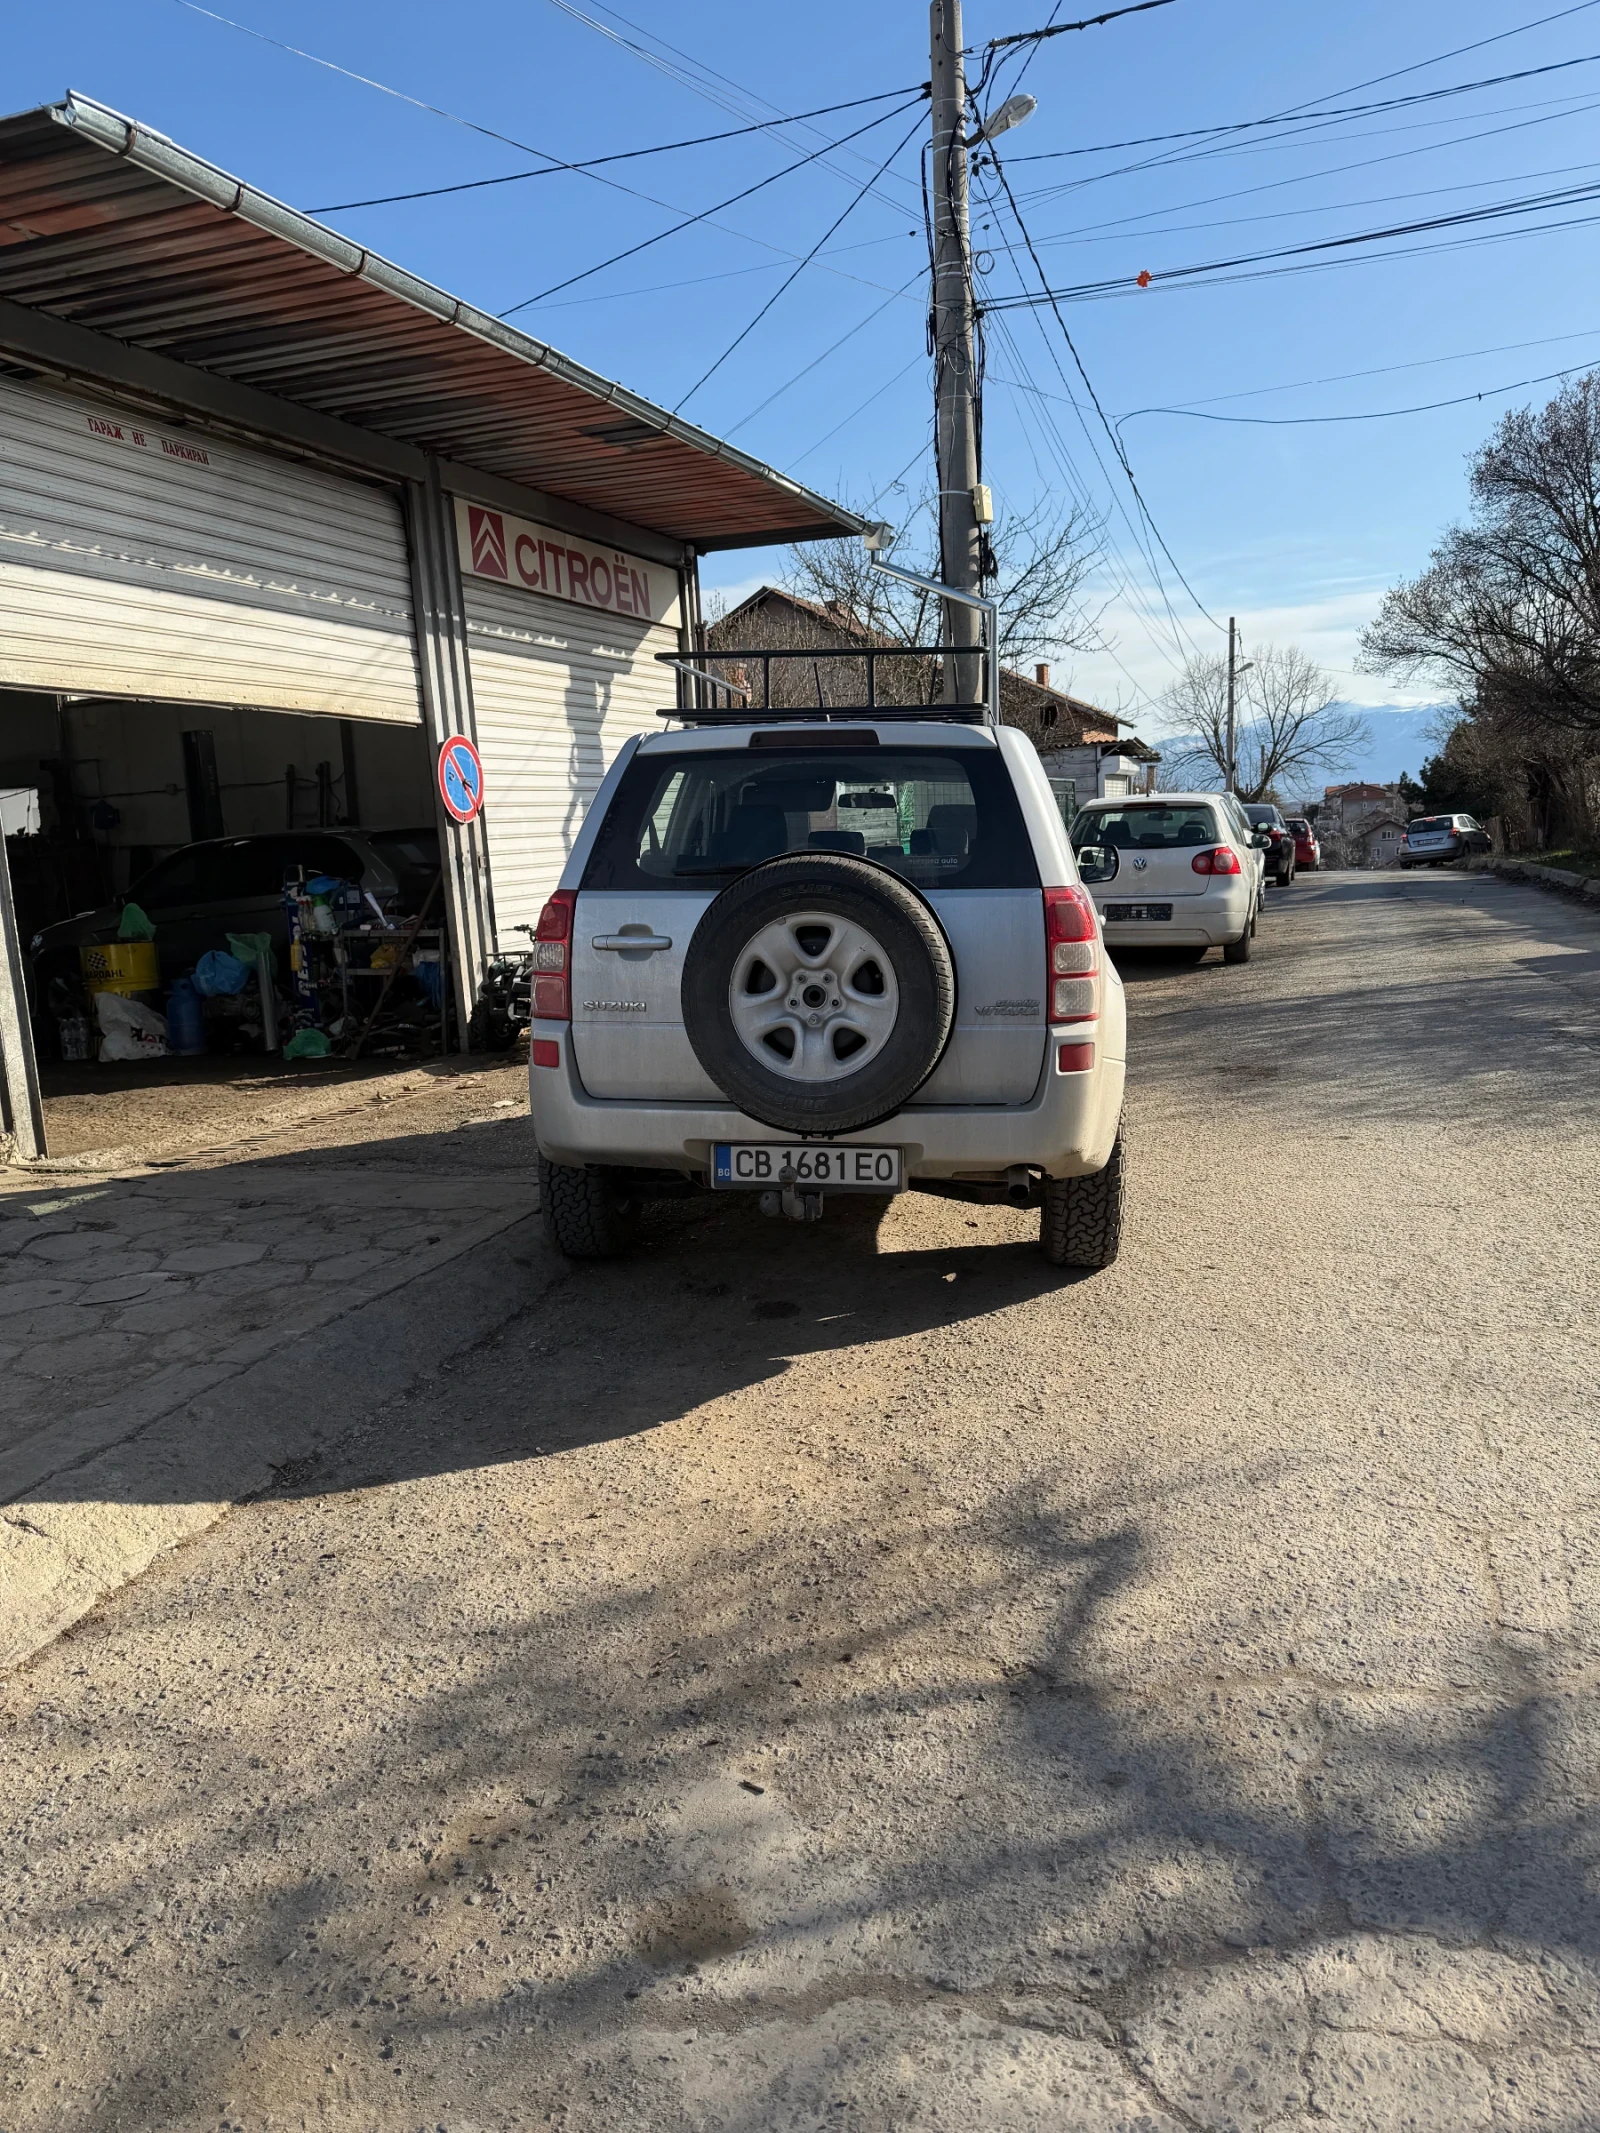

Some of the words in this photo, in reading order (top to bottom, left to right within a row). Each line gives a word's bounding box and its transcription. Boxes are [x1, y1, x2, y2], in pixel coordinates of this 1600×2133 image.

[87, 418, 125, 441] ГАРАЖ
[132, 431, 147, 447] НЕ
[515, 534, 652, 617] CITROËN
[583, 1000, 647, 1012] SUZUKI
[996, 999, 1040, 1007] GRAND
[974, 1006, 1040, 1016] VITARA
[736, 1150, 772, 1178] CB
[782, 1151, 846, 1179] 1681
[717, 1168, 730, 1177] BG
